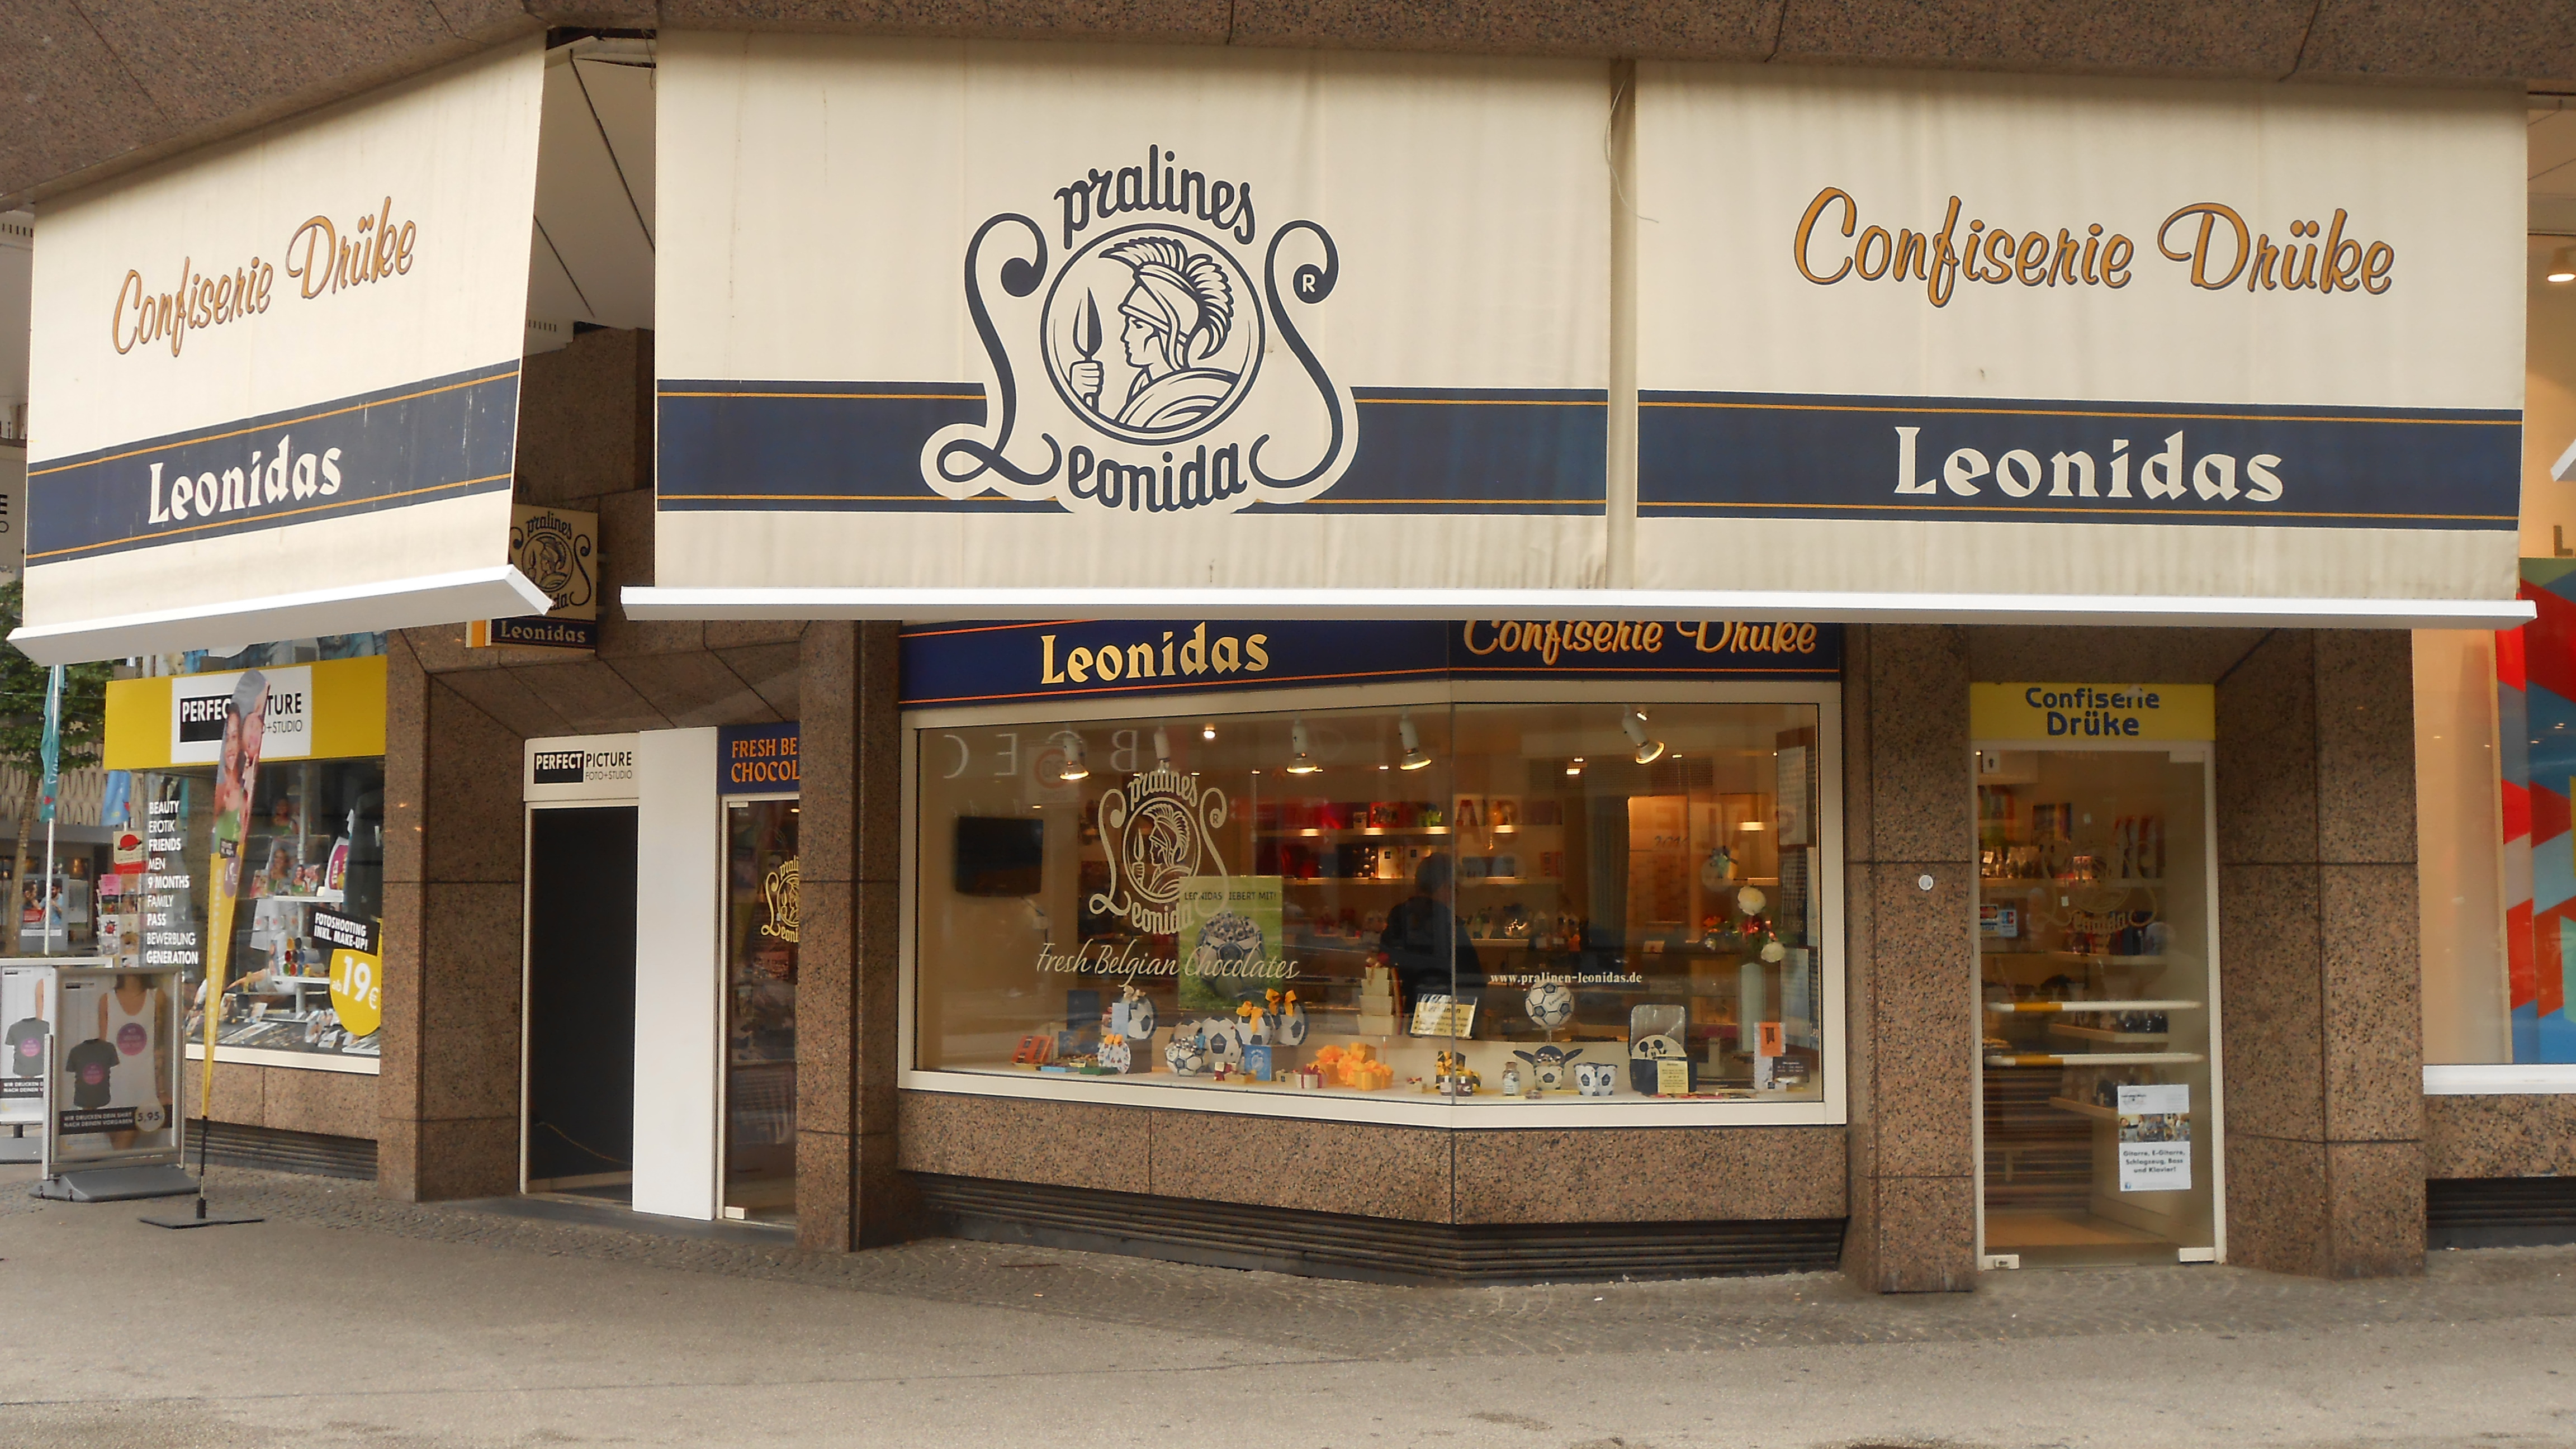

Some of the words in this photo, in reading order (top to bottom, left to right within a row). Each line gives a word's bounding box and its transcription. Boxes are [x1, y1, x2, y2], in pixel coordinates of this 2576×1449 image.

[1054, 144, 1255, 249] pralines
[1793, 186, 2135, 307] Confiserie
[2157, 202, 2395, 295] Drüke
[112, 255, 273, 357] Confiserie
[286, 196, 416, 299] Drüke
[1893, 425, 2284, 502] Leonidas
[148, 434, 342, 524] Leonidas
[525, 511, 572, 539] pralines
[501, 620, 585, 643] Leonidas
[1041, 622, 1270, 684] Leonidas
[182, 699, 231, 722] PERFEC
[267, 693, 302, 716] TURE
[2026, 688, 2160, 709] Confiserie
[2047, 711, 2139, 736] Drüke
[732, 738, 776, 759] FRESH
[780, 737, 797, 755] BE
[536, 753, 583, 770] PERFECT
[586, 751, 632, 768] PICTURE
[731, 759, 799, 783] CHOCOL
[585, 770, 632, 782] FOTO+STUDIO
[149, 800, 180, 815] BEAUTY
[149, 820, 175, 834] EROTIK
[149, 838, 181, 852] FRIENDS
[148, 858, 165, 870] MEN
[148, 877, 153, 888] 9
[154, 875, 190, 889] MONTHS
[147, 895, 173, 908] FAMILY
[1258, 891, 1276, 901] MIT!
[147, 913, 166, 926] PASS
[315, 912, 367, 938] FOTOSHOOTING
[146, 932, 196, 945] BEWERBUNG
[314, 925, 332, 941] INKL.
[333, 931, 368, 951] MAKE-UP!
[146, 950, 198, 965] GENERATION
[1036, 938, 1094, 972] Fresh
[1094, 939, 1180, 987] Belgian
[1185, 941, 1300, 979] Chocolates
[332, 979, 343, 993] ab
[1490, 972, 1642, 985] www.pralinen-leonidas.de
[138, 1111, 160, 1123] 5,95
